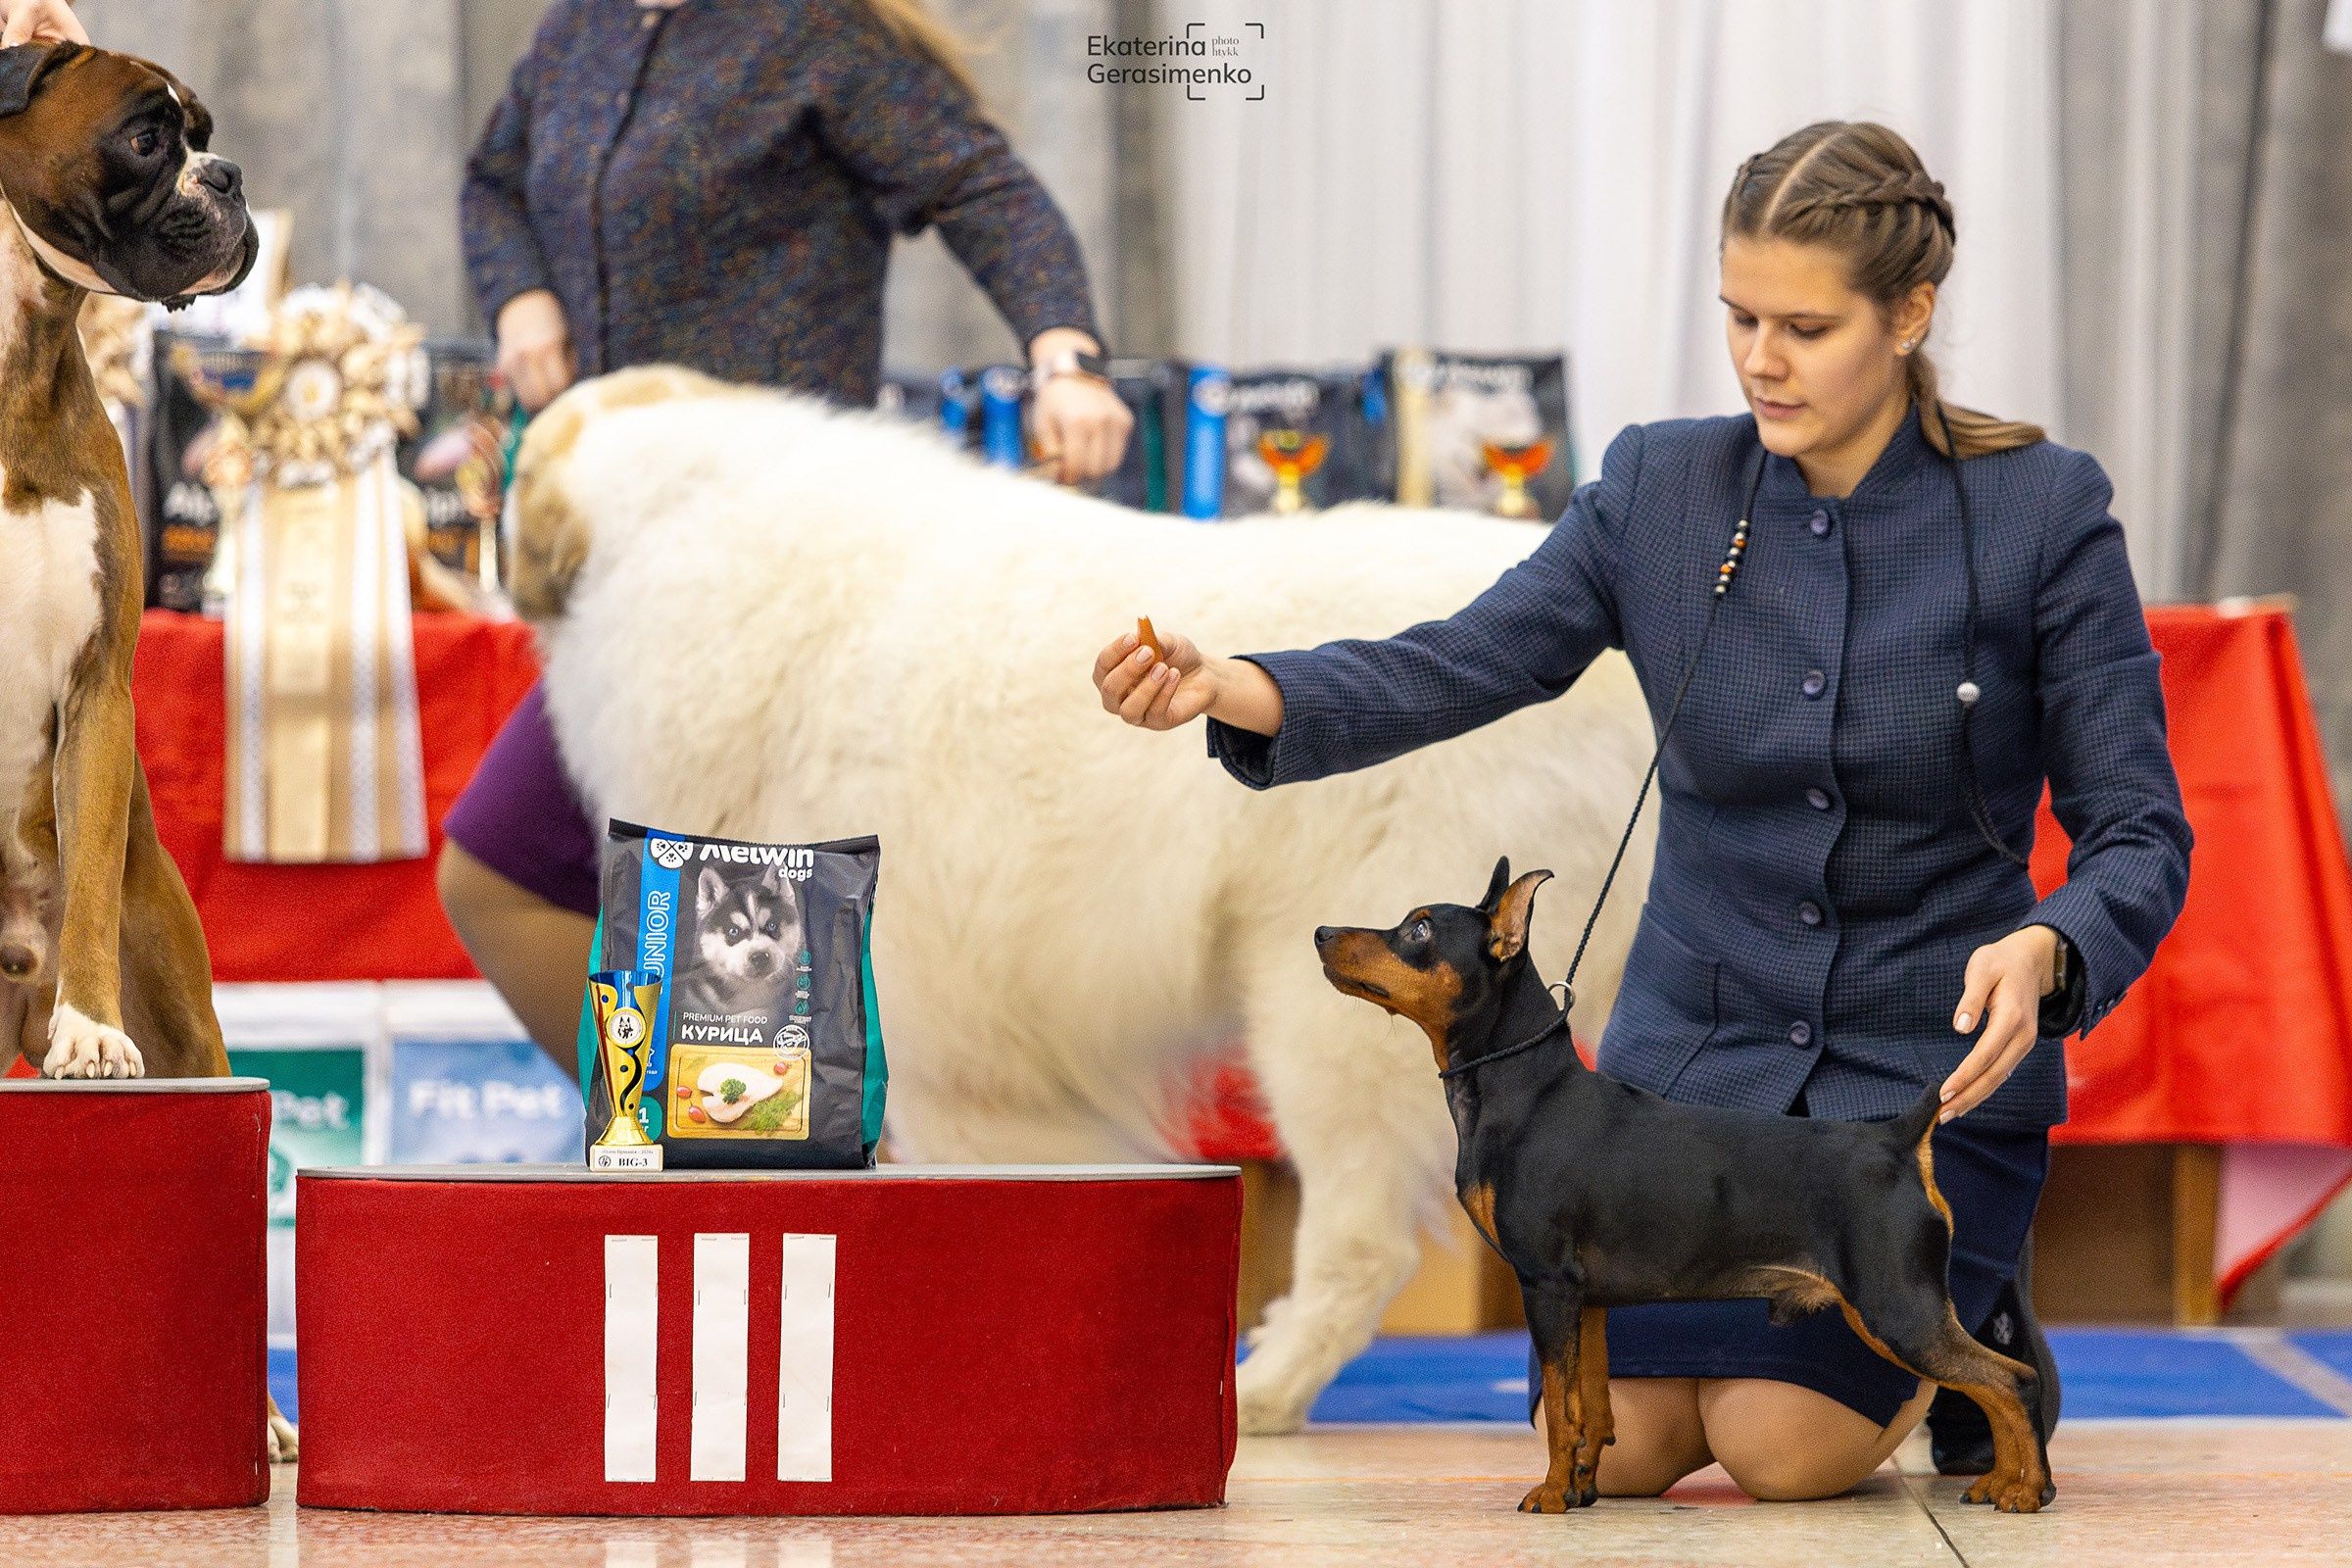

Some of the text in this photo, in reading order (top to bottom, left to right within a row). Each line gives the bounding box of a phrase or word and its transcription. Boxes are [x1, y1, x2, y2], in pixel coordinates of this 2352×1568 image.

[778, 864, 813, 881] dogs
[643, 890, 671, 995] UNIOR
[683, 1011, 768, 1025] PREMIUM PET FOOD
[681, 1024, 763, 1046] КУРИЦА
[482, 1079, 564, 1120] Pet
[618, 1157, 648, 1167] BIG-3
